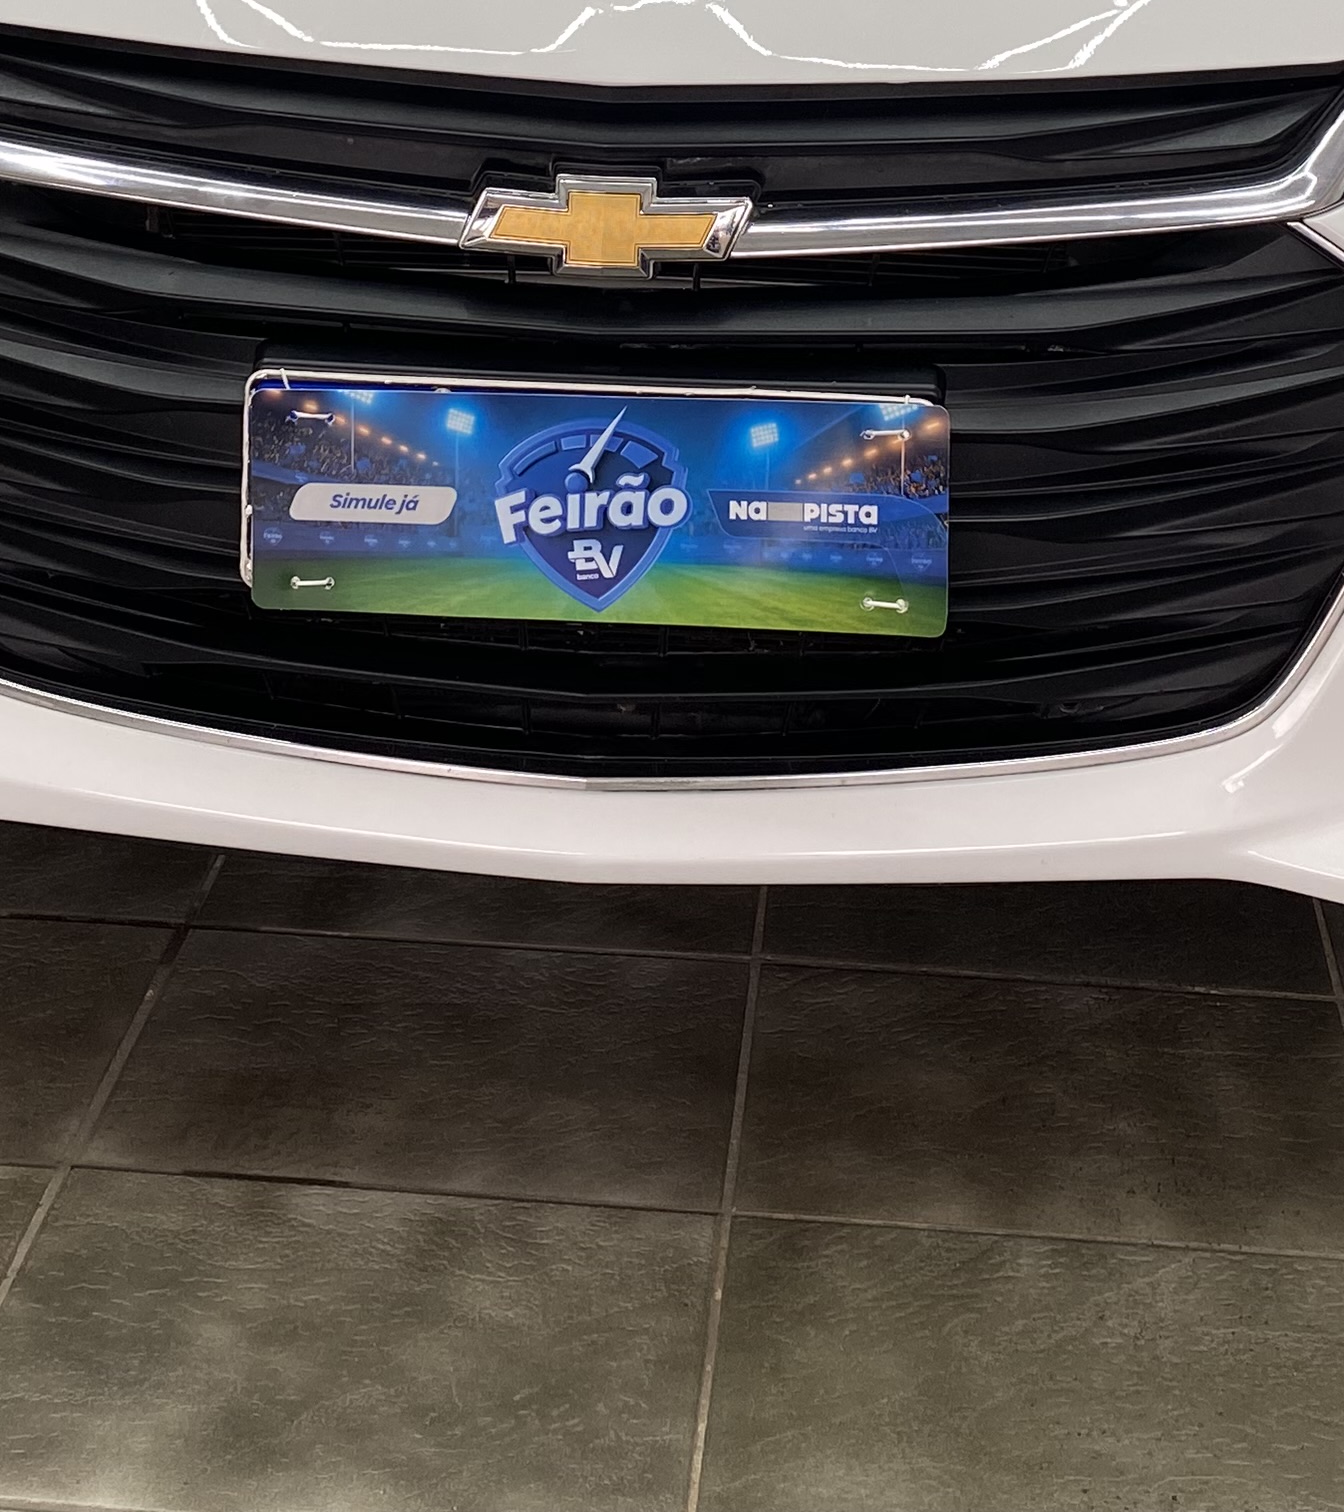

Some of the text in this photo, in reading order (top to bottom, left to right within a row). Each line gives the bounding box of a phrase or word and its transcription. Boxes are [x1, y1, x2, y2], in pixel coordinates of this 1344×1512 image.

[329, 492, 420, 514] Simule já
[494, 473, 688, 545] Feirão
[847, 526, 868, 534] banco
[567, 539, 624, 579] BV
[576, 572, 600, 581] banco
